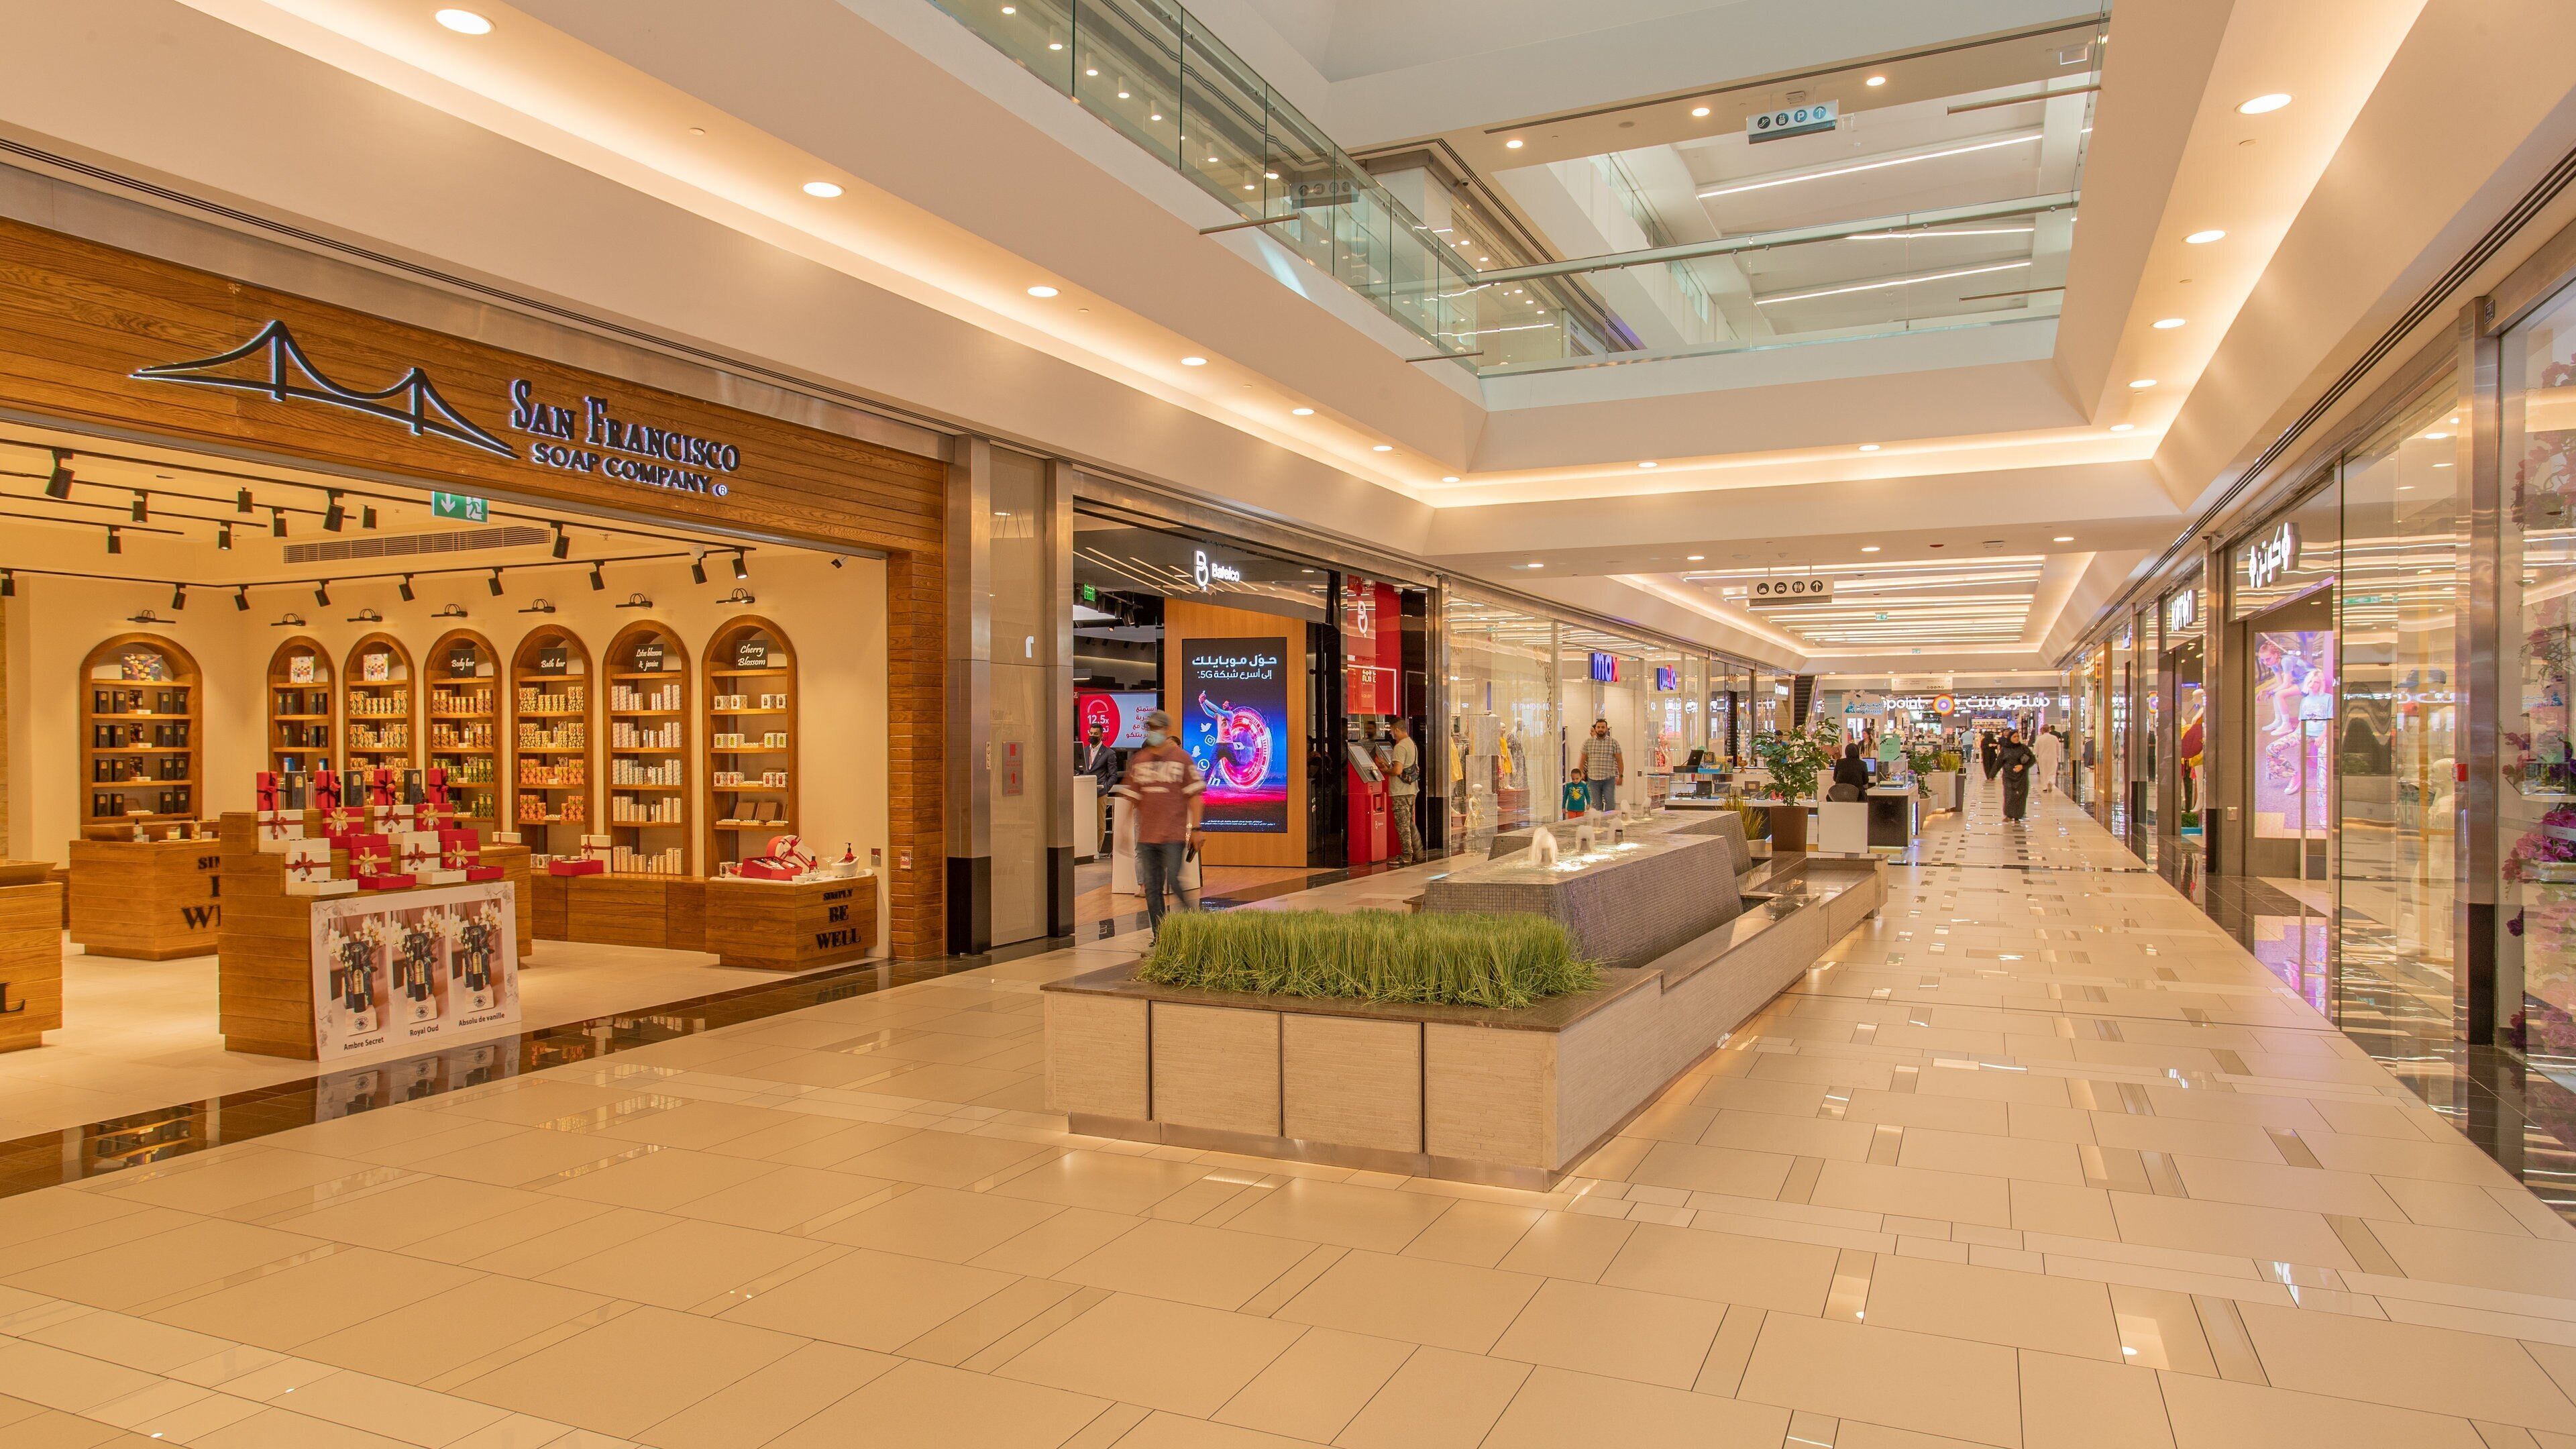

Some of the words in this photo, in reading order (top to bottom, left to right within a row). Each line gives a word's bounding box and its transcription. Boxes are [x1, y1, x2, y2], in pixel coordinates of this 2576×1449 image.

[531, 442, 600, 472] SOAP
[603, 456, 712, 493] COMPANY
[1211, 563, 1240, 582] Batelco
[740, 643, 764, 657] Cherry
[451, 658, 465, 671] Body
[466, 658, 475, 666] bar
[541, 658, 554, 667] Bath
[555, 658, 566, 667] bar
[738, 656, 765, 665] Blossom
[1192, 655, 1247, 668] موبايلك
[1240, 668, 1260, 680] أسرع
[1594, 653, 1619, 682] max
[1214, 669, 1238, 680] شبكة
[1261, 669, 1272, 680] إلى
[1087, 714, 1110, 724] 12.5x
[823, 889, 853, 901] SIMPLY
[828, 905, 849, 923] BE
[816, 928, 861, 949] WELL
[459, 1018, 478, 1026] Absolu
[486, 1012, 505, 1022] vanille
[409, 1028, 426, 1037] Royal
[427, 1024, 439, 1033] Oud
[343, 1040, 364, 1051] Ambre
[364, 1036, 384, 1046] Secret
